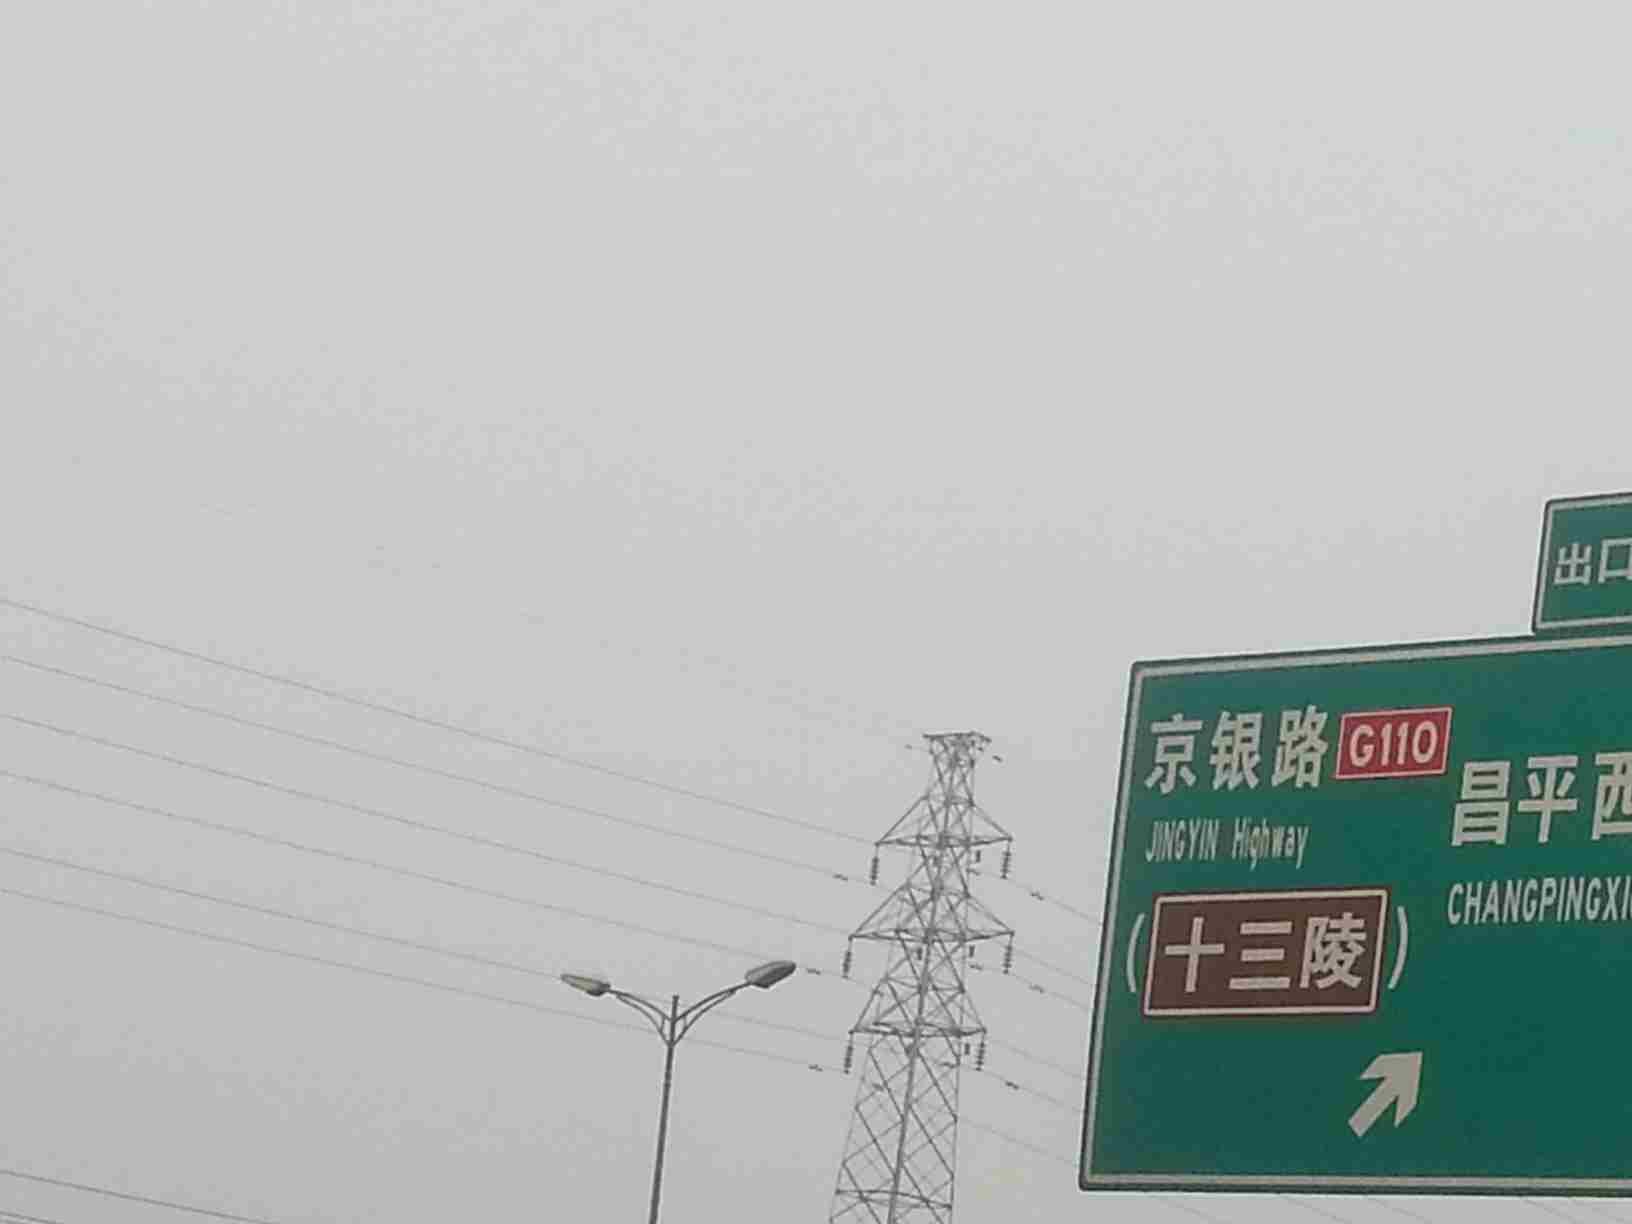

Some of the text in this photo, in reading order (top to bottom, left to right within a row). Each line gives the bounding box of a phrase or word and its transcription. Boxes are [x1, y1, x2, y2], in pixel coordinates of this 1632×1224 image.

[1144, 704, 1439, 793] 京银路 G110
[1145, 818, 1309, 870] JINGYIN Highway
